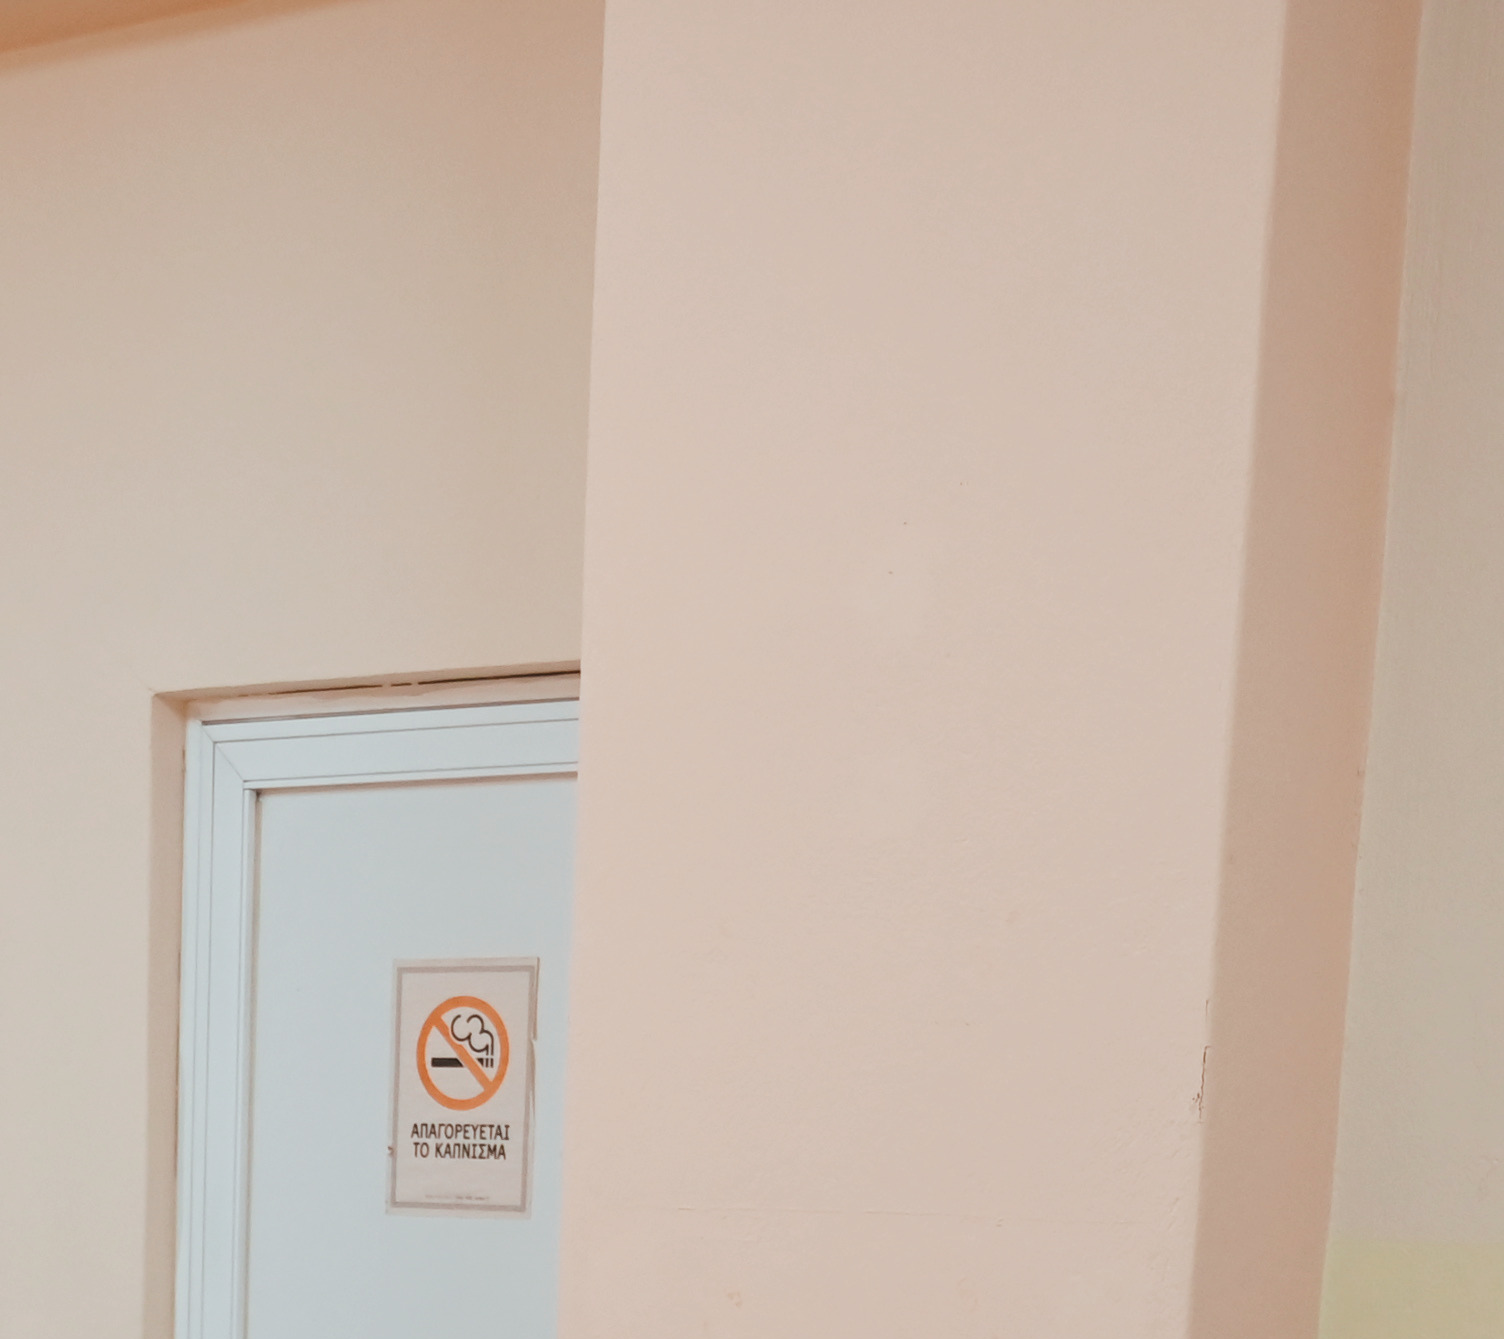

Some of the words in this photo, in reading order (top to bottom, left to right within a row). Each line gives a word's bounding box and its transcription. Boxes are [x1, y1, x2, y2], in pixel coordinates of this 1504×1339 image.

[410, 1123, 510, 1141] ΑΠΑΓΟΡΕΥΕΤΑΙ
[413, 1142, 430, 1158] ΤΟ
[435, 1143, 507, 1160] ΚΑΠΝΙΣΜΑ
